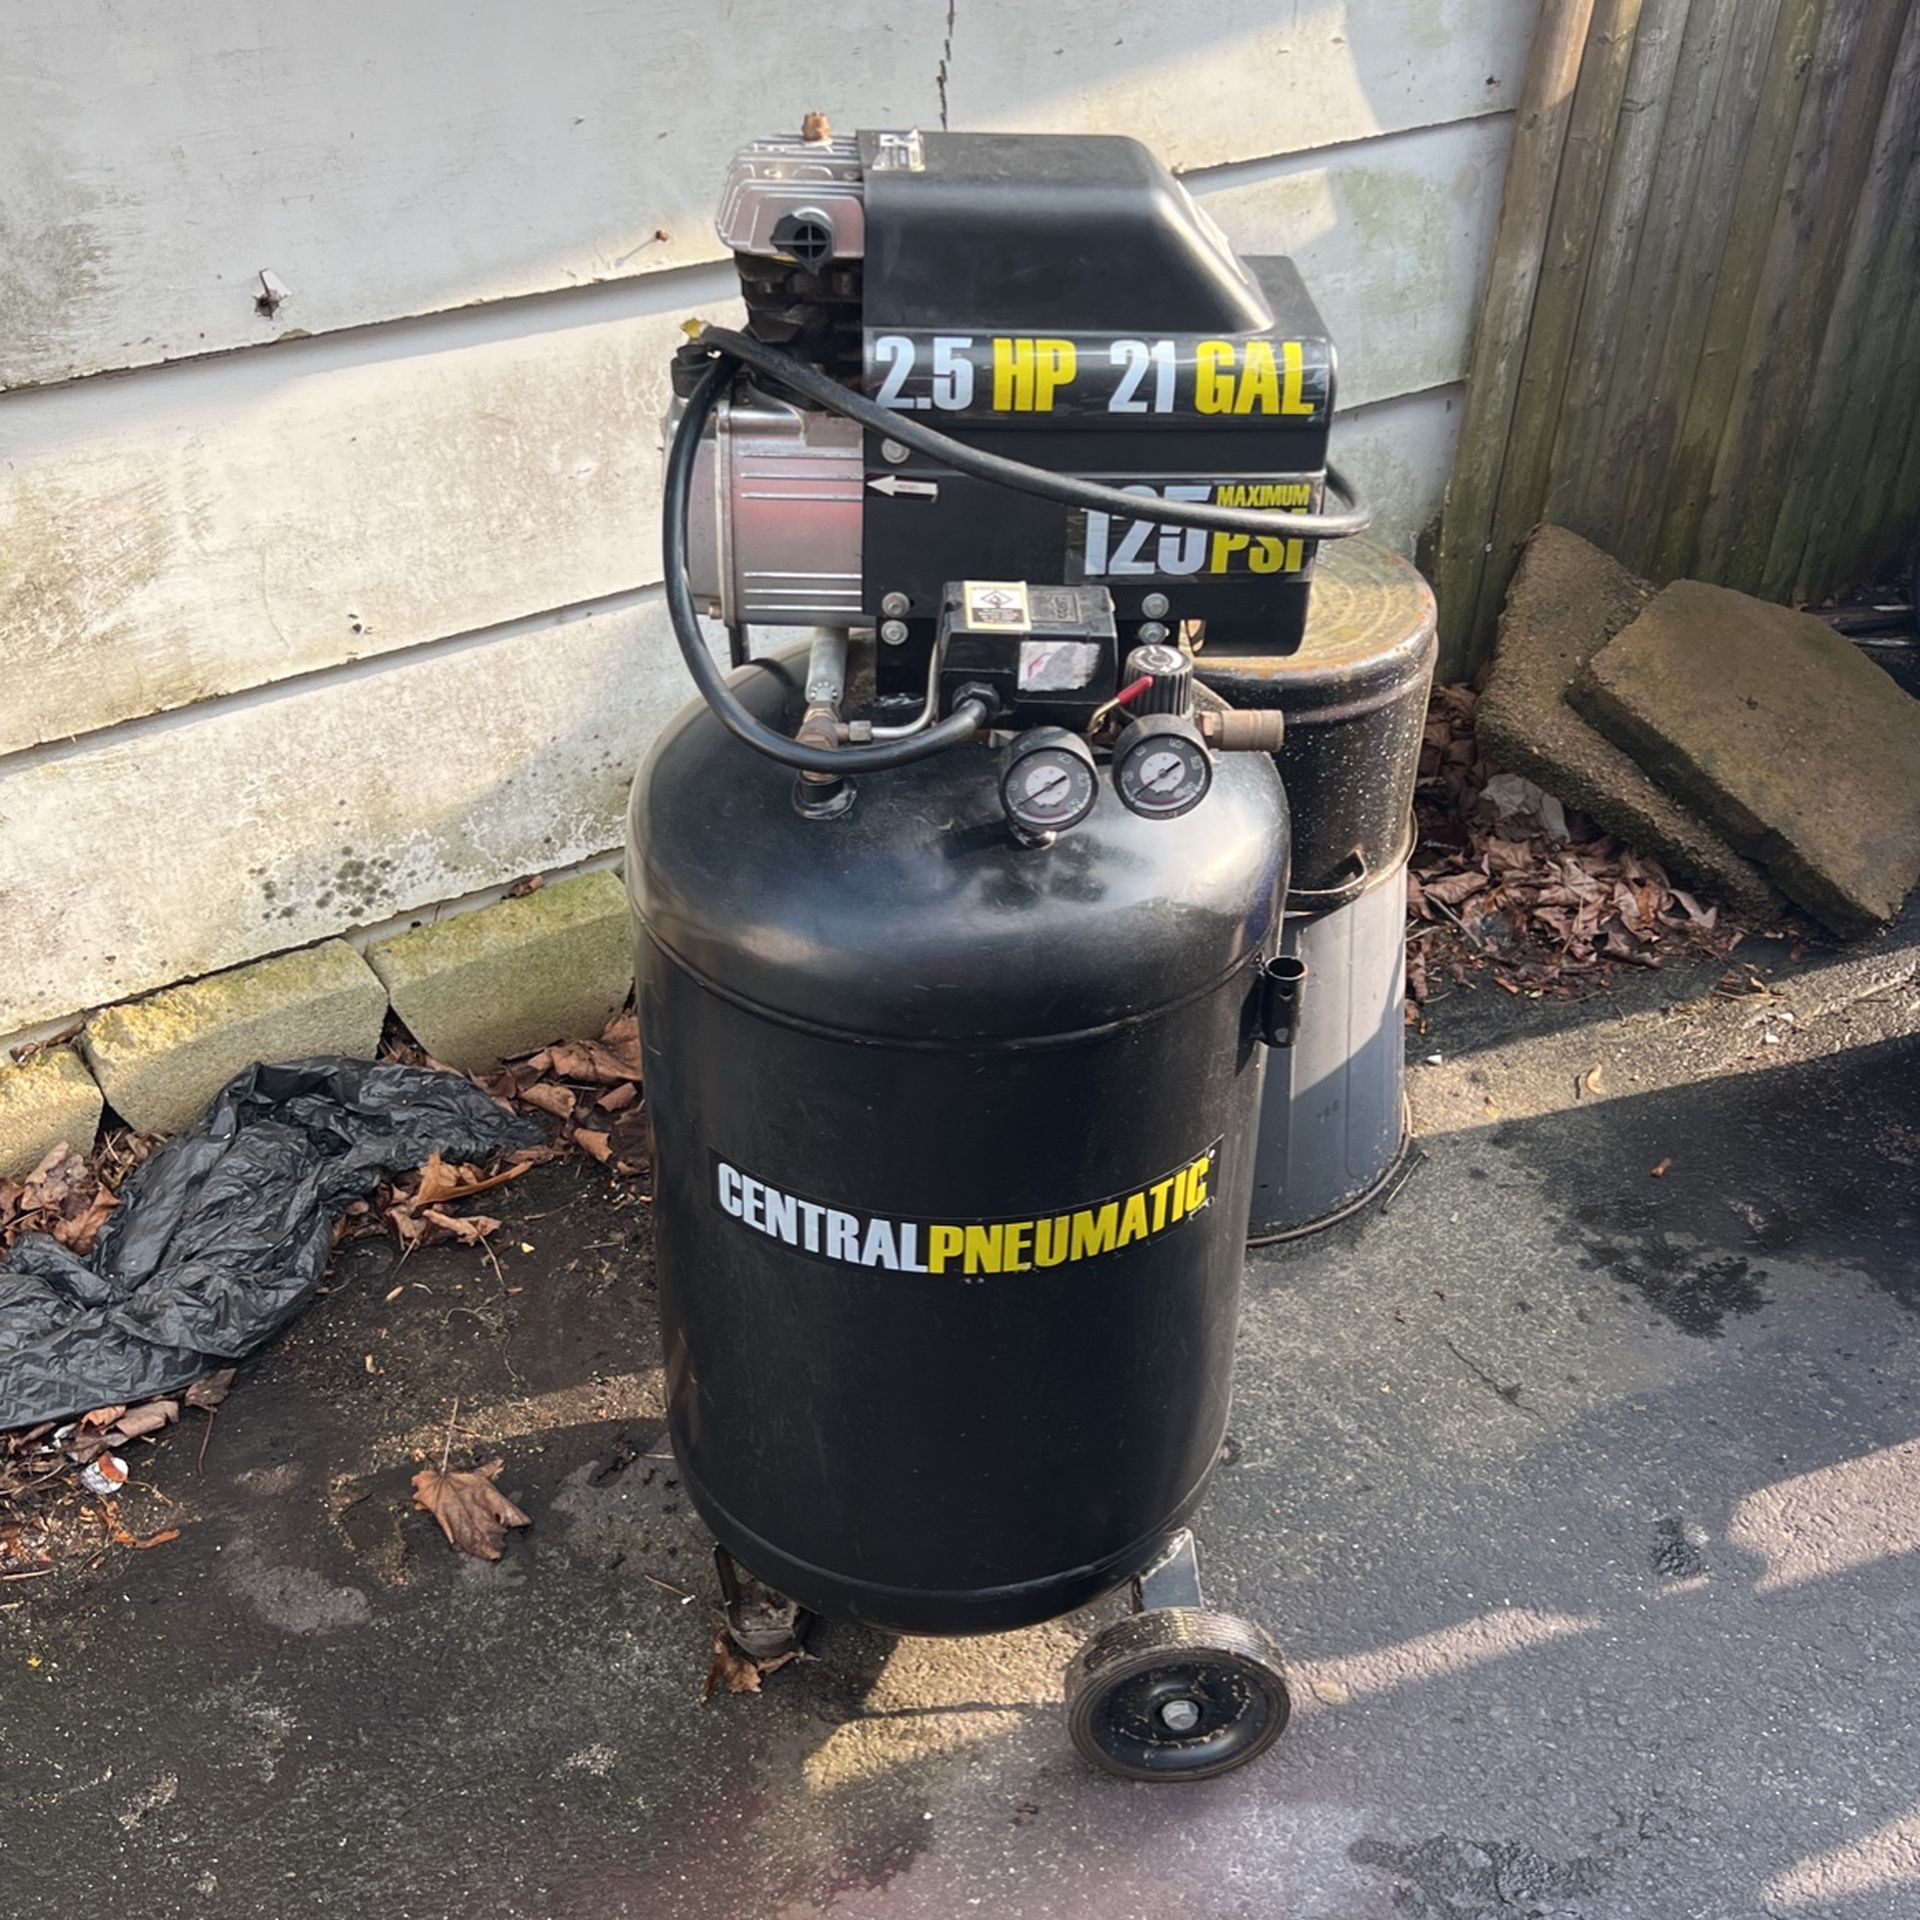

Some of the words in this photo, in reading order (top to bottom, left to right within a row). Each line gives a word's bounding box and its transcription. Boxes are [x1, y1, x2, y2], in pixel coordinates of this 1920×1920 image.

[875, 336, 973, 411] 2.5
[992, 337, 1076, 412] HP
[1109, 340, 1176, 414] 21
[1195, 341, 1315, 415] GAL
[1216, 485, 1311, 507] MAXIMUM
[1211, 508, 1308, 574] PSI
